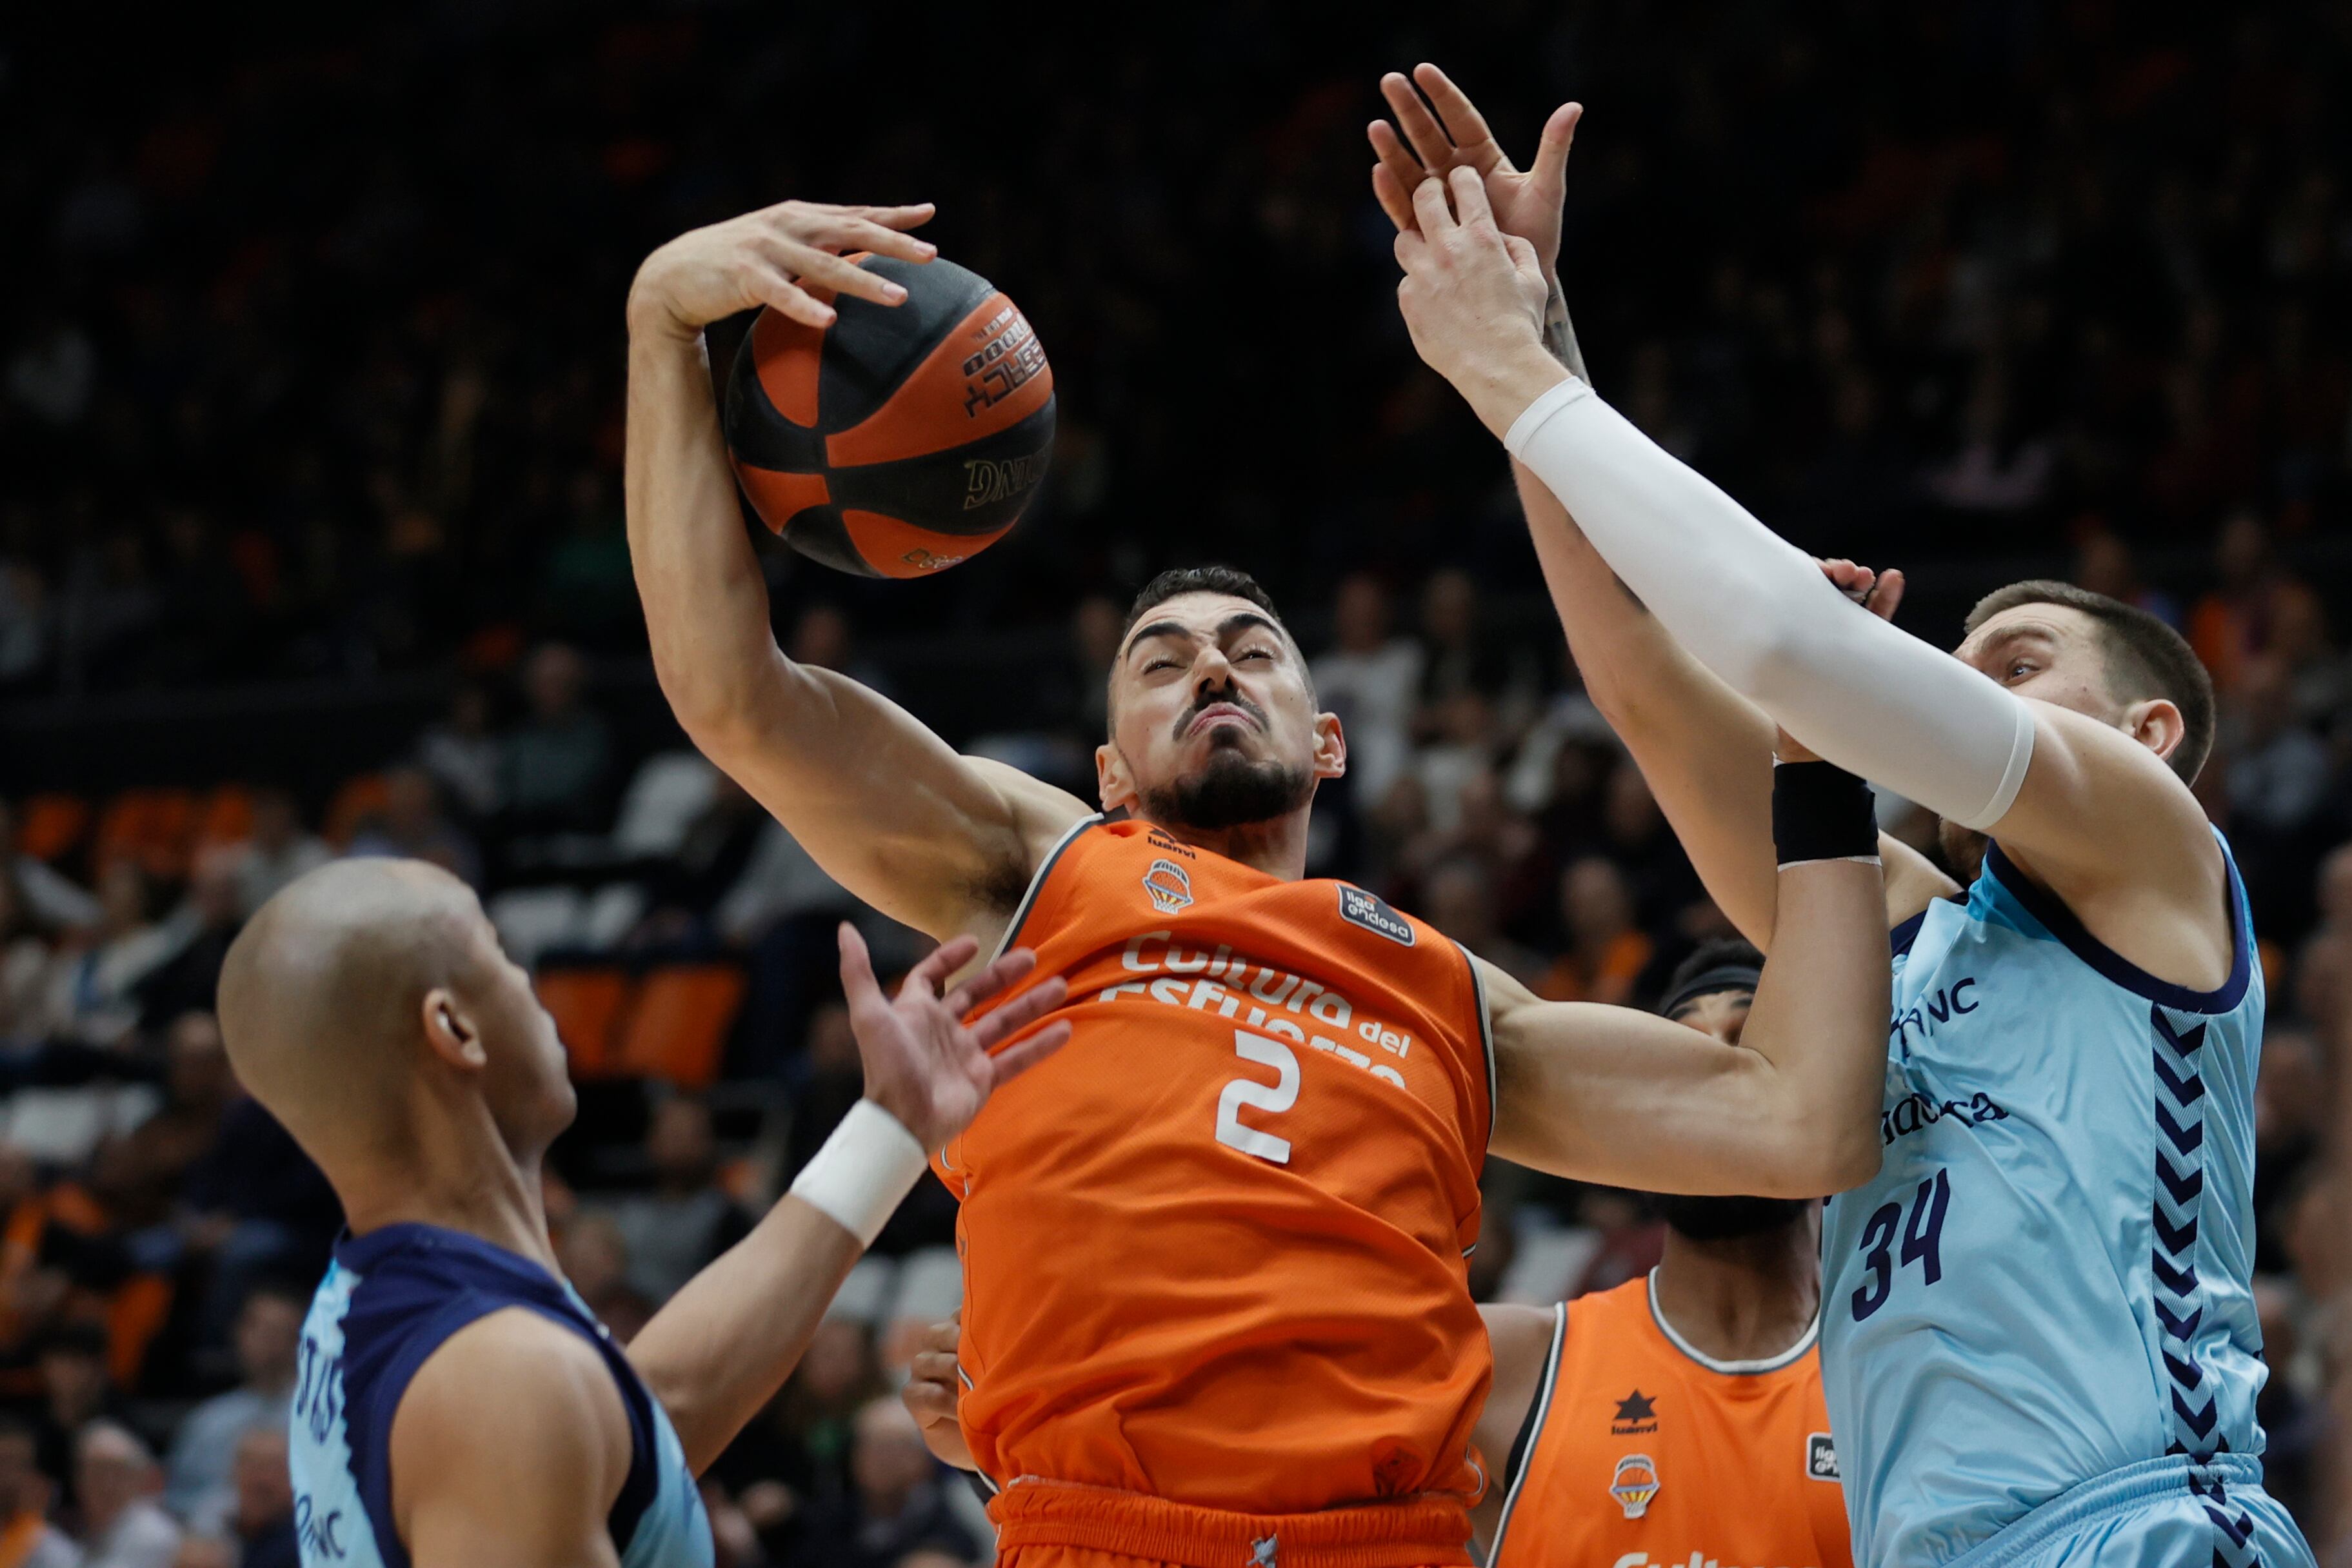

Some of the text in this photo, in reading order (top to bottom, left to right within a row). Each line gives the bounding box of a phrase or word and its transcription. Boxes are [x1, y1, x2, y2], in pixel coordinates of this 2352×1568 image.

[1346, 891, 1375, 912] liga
[1348, 903, 1408, 938] endesa
[1122, 930, 1411, 1059] Cultura del
[1215, 1029, 1301, 1164] 2
[1851, 1167, 1951, 1322] 34
